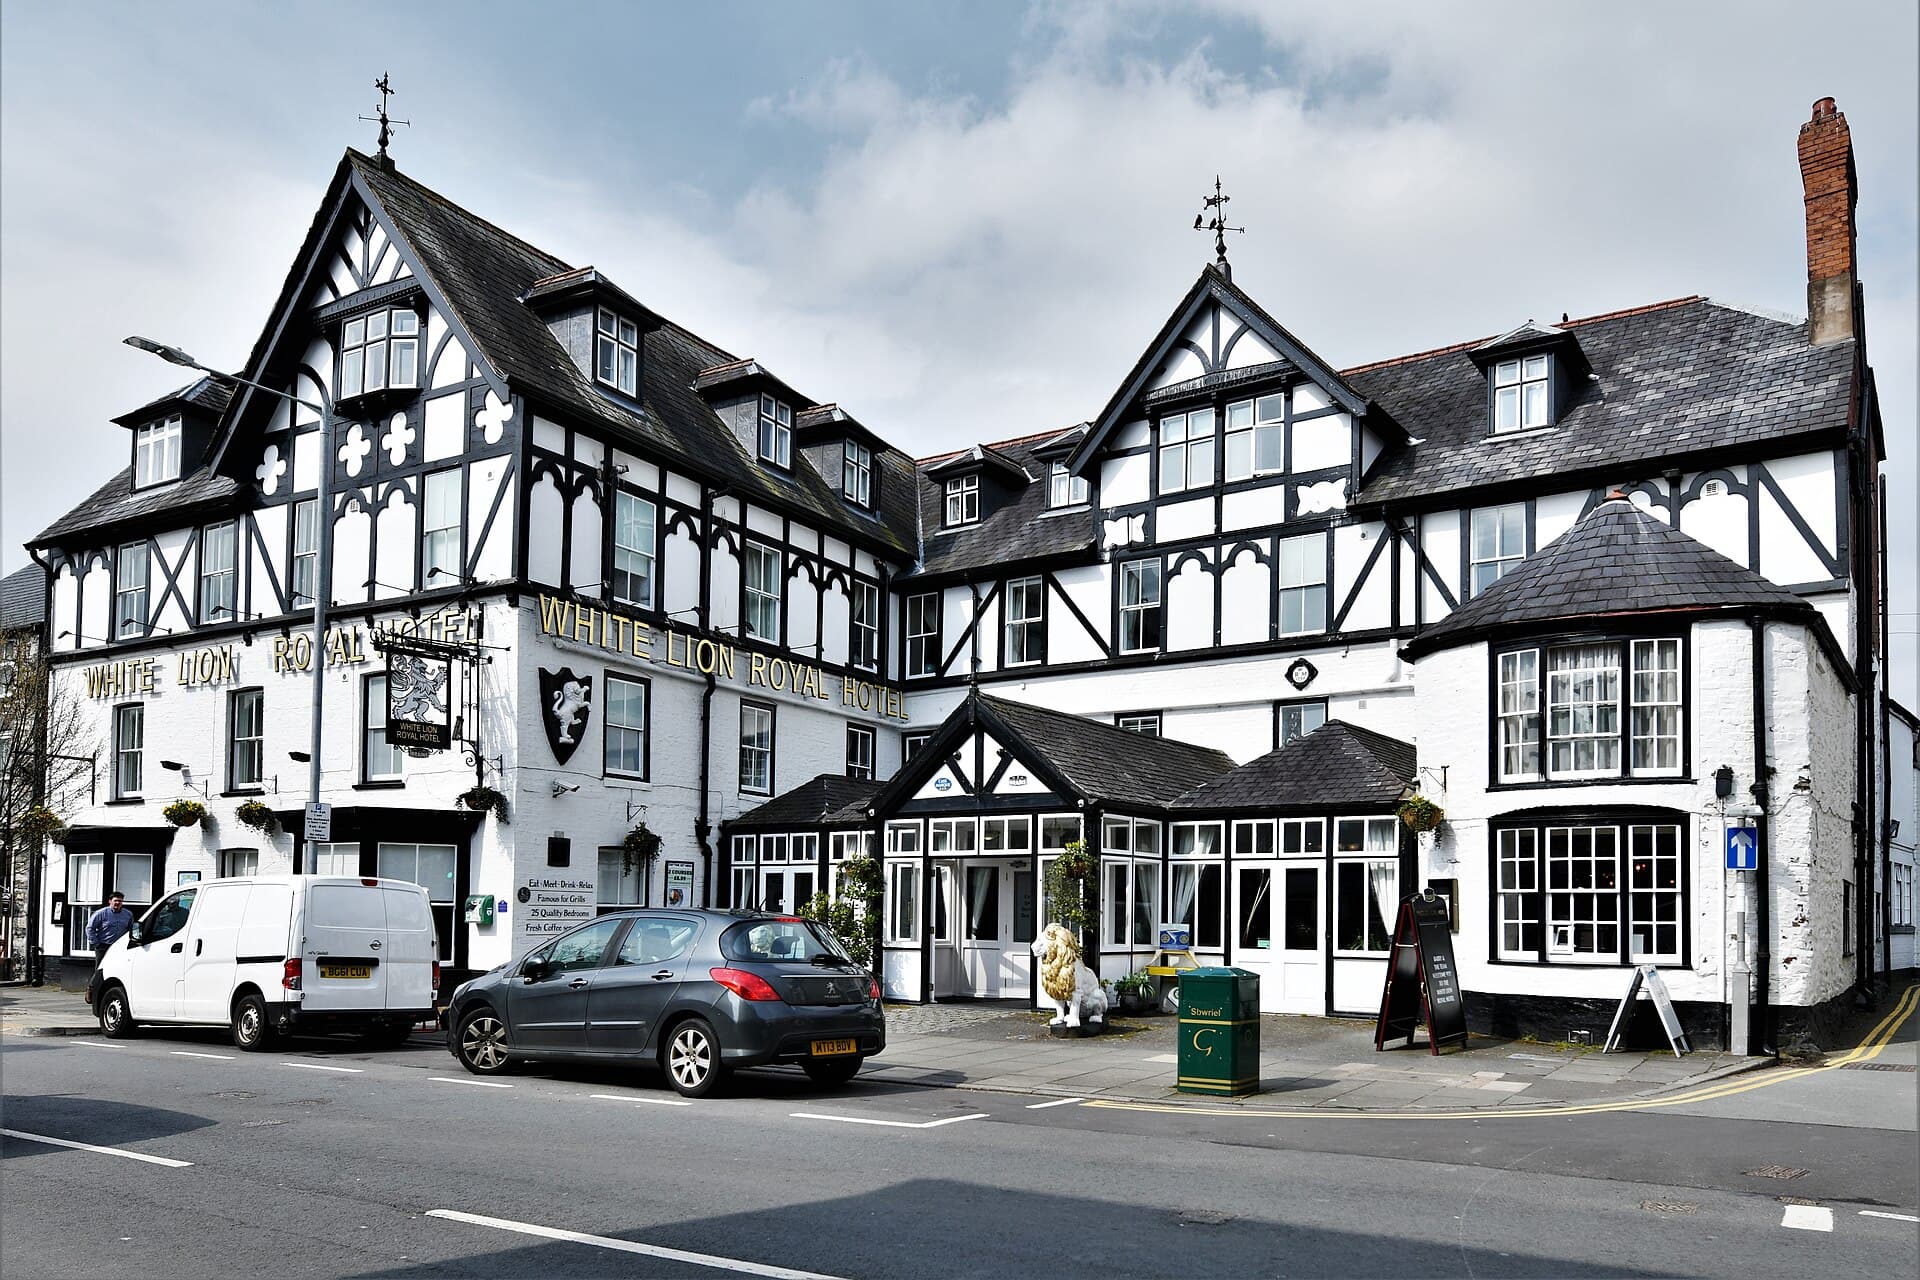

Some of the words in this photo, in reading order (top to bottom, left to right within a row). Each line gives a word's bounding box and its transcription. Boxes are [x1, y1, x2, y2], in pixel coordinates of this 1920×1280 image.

[539, 593, 651, 659] WHITE
[667, 629, 735, 680] LION
[750, 652, 830, 701] ROYAL
[842, 675, 910, 721] HOTEL
[86, 656, 155, 699] WHITE
[176, 644, 233, 686] LION
[400, 722, 421, 732] WHITE
[422, 725, 438, 734] LION
[397, 730, 418, 740] ROYAL
[420, 733, 441, 743] HOTEL
[543, 879, 558, 888] Meet
[561, 880, 576, 888] Drink
[537, 894, 560, 903] Famous
[560, 894, 569, 903] for
[570, 895, 586, 903] Grills
[531, 908, 539, 917] 25
[540, 908, 562, 918] Quality
[563, 909, 590, 917] Bedrooms
[526, 923, 542, 932] Fresh
[543, 923, 562, 932] Coffee
[328, 967, 348, 976] BG61
[350, 967, 367, 976] CUA
[1191, 1007, 1221, 1017] Sbwriel
